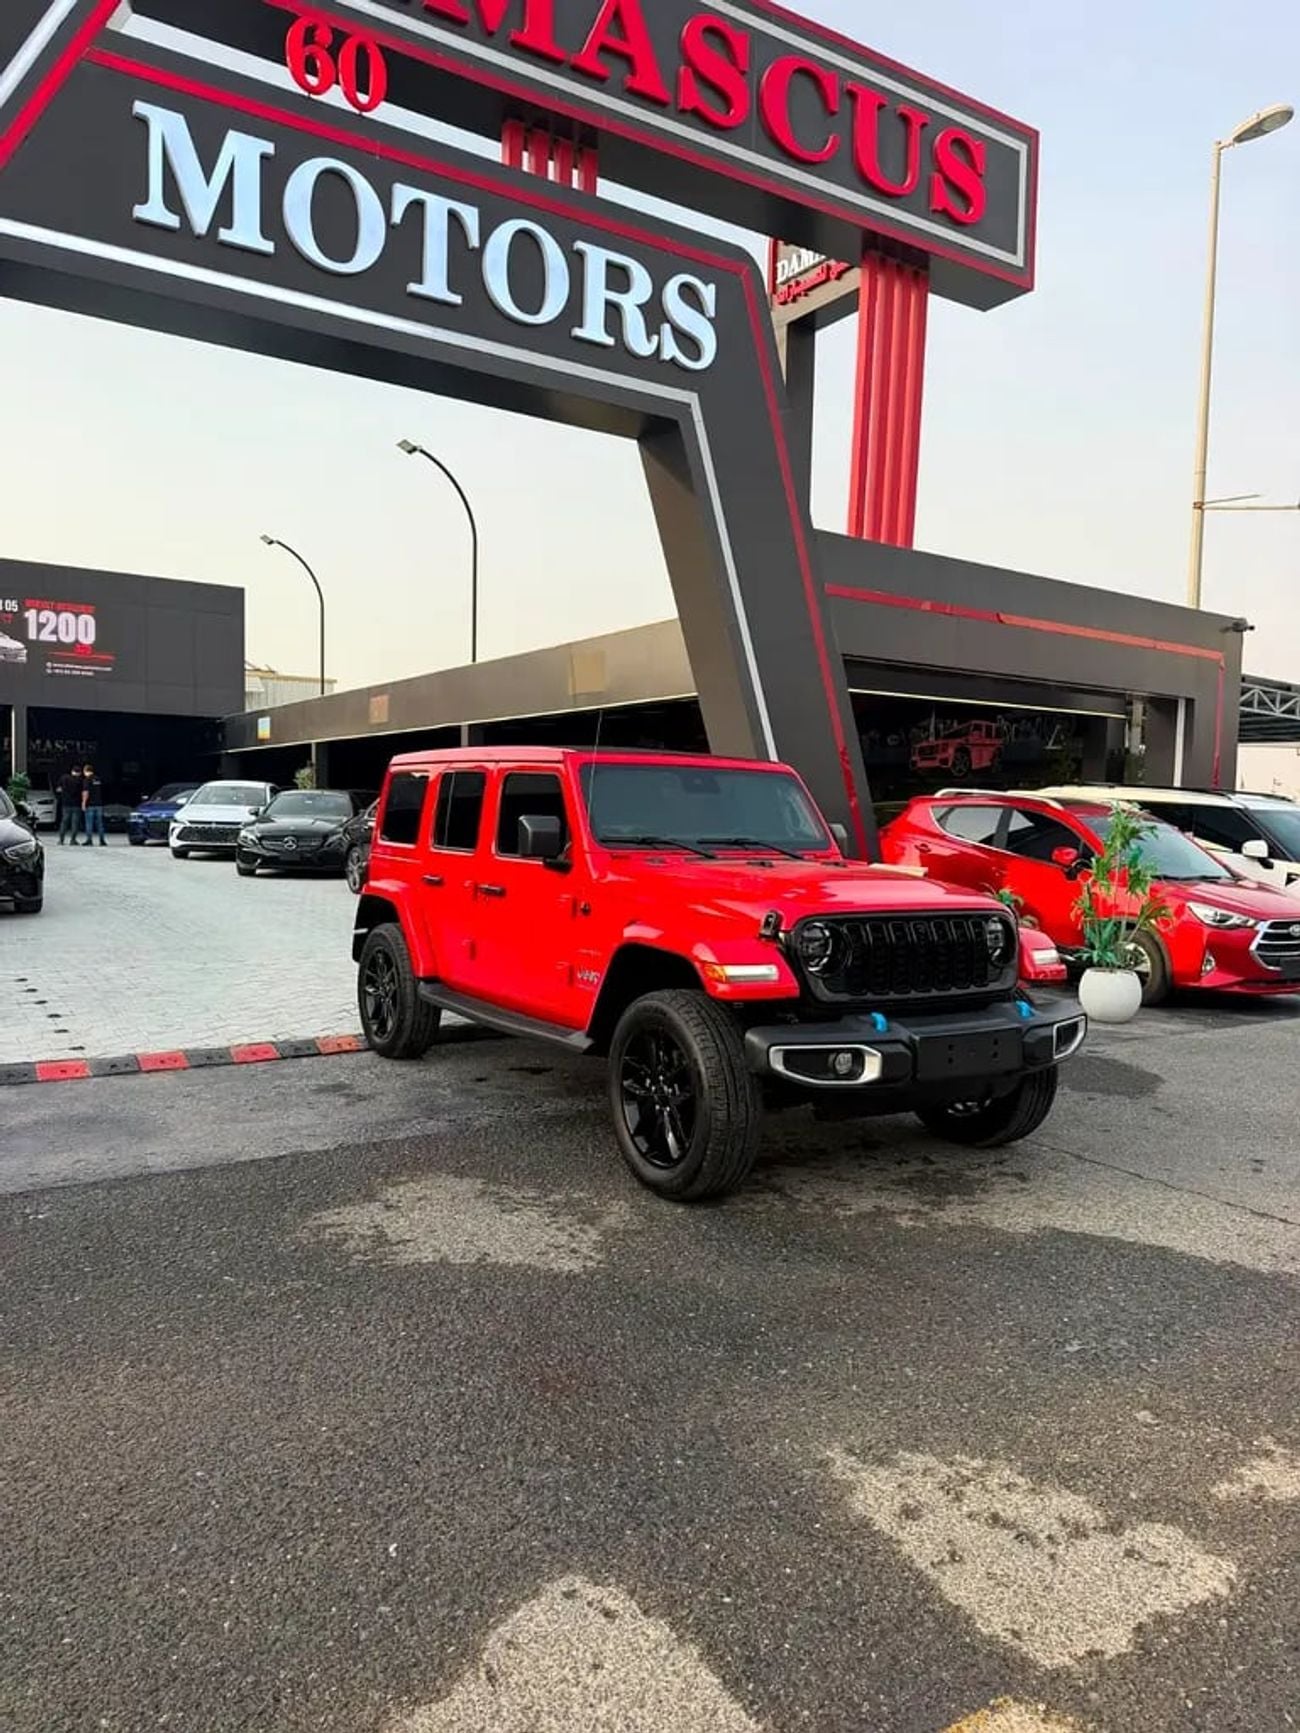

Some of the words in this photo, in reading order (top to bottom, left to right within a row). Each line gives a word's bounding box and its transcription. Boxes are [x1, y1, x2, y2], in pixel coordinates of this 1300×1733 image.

[285, 14, 388, 113] 60
[132, 99, 717, 370] MOTORS
[24, 608, 96, 645] 1200
